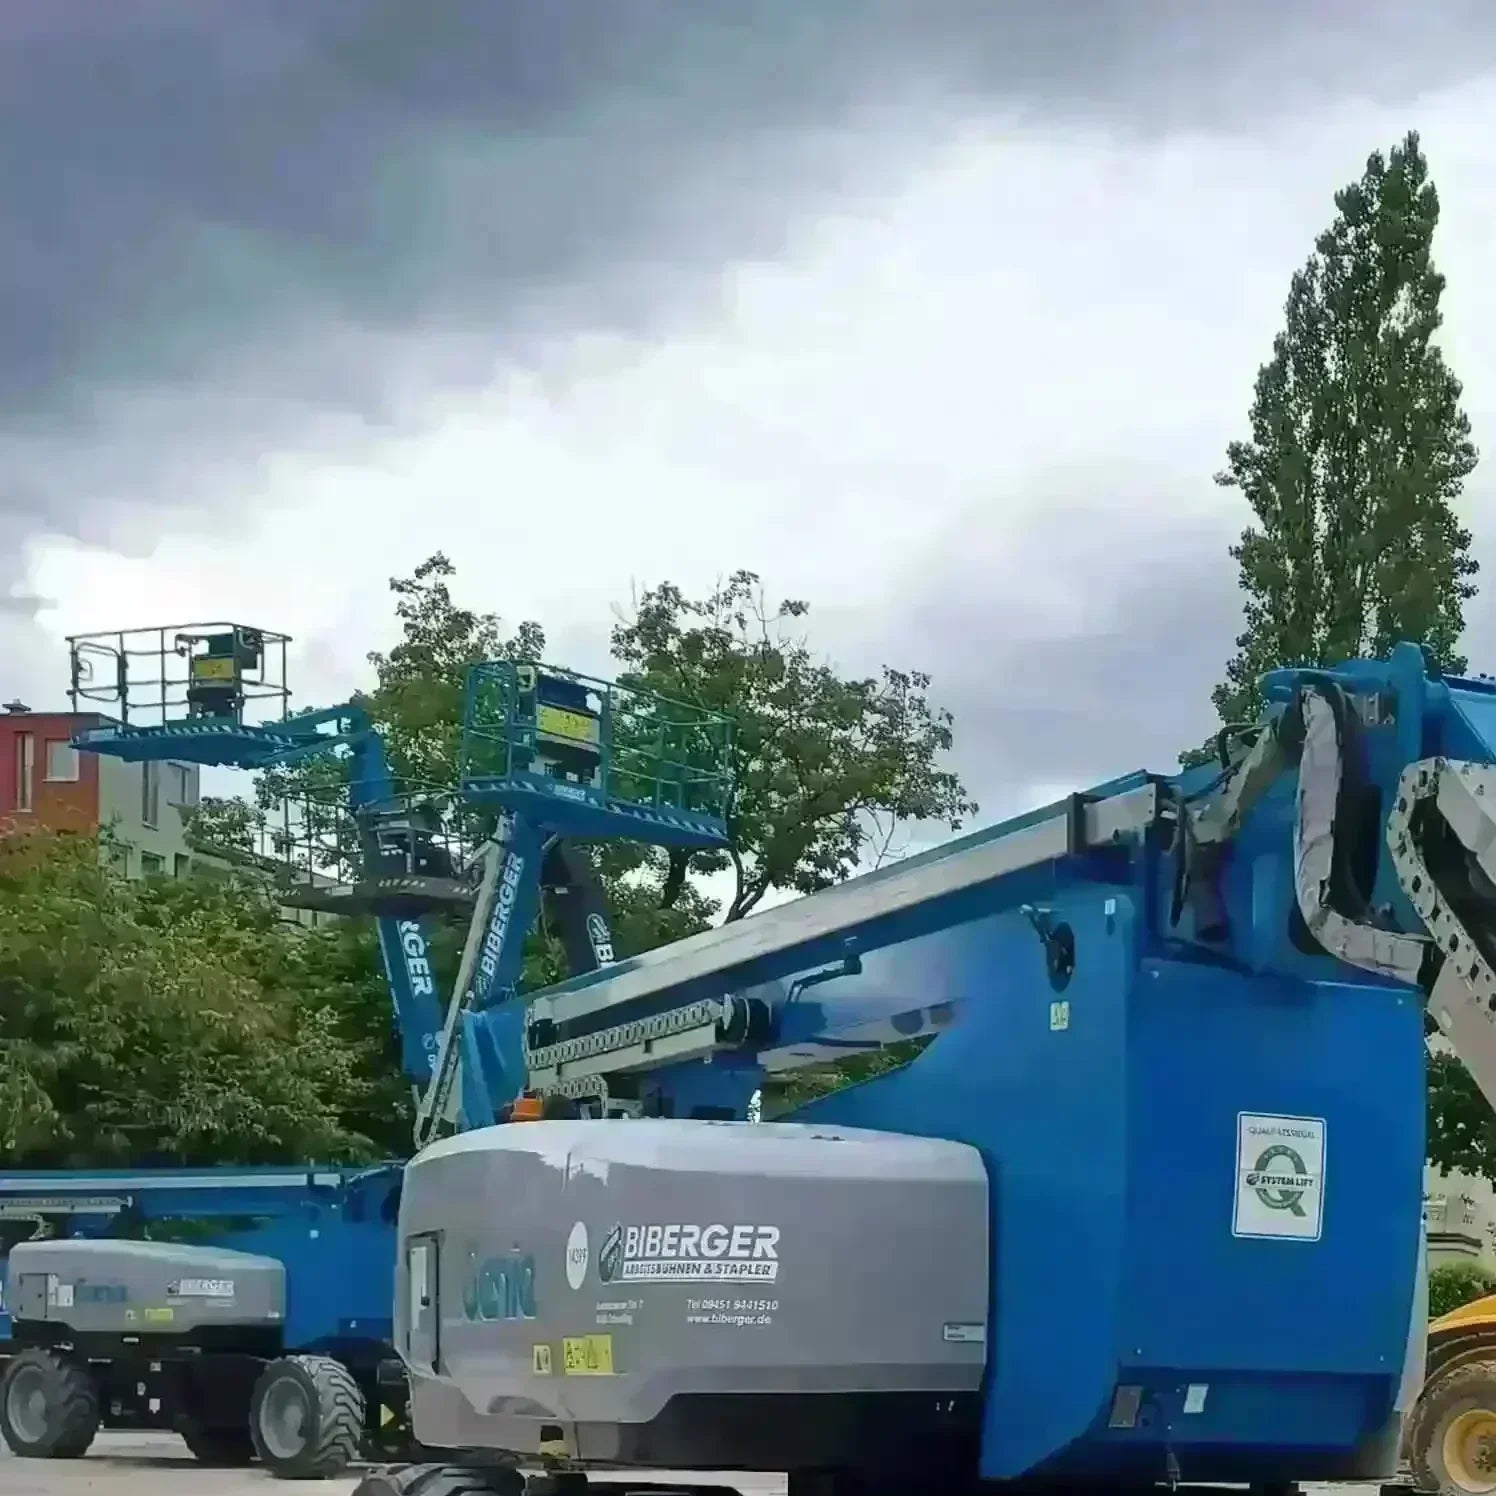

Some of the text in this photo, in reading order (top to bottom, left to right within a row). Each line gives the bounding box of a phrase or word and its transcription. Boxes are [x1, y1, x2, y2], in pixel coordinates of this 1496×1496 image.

[480, 851, 525, 977] BIBERGER
[624, 1225, 780, 1258] BIBERGER
[715, 1263, 772, 1276] STAPLER
